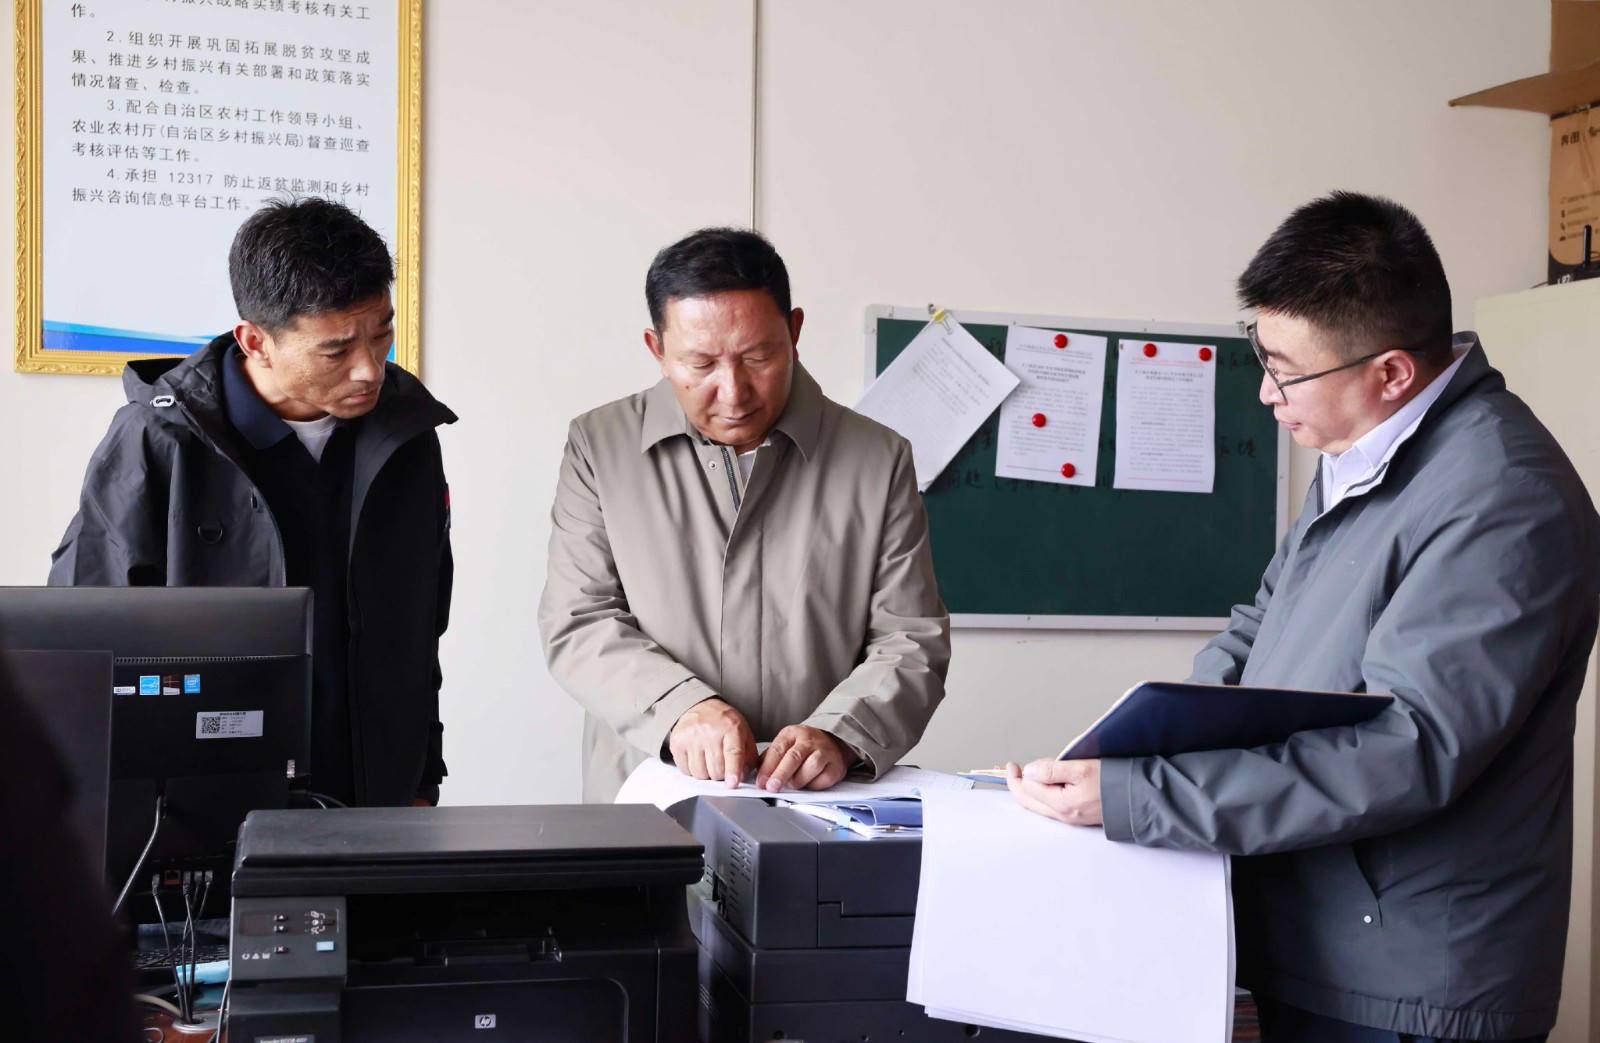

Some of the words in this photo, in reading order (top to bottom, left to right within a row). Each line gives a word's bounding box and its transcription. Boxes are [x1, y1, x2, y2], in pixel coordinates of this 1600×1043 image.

[71, 3, 97, 19] 作。
[71, 49, 371, 87] 果、推进乡村振兴有关部署和政策落实
[71, 72, 199, 95] 情况督查、检查。
[71, 142, 200, 163] 考核评估等工作。
[169, 172, 213, 186] 12317
[224, 174, 370, 197] 防止返贫监测和乡村
[71, 187, 250, 211] 振兴咨询信息平台工作。
